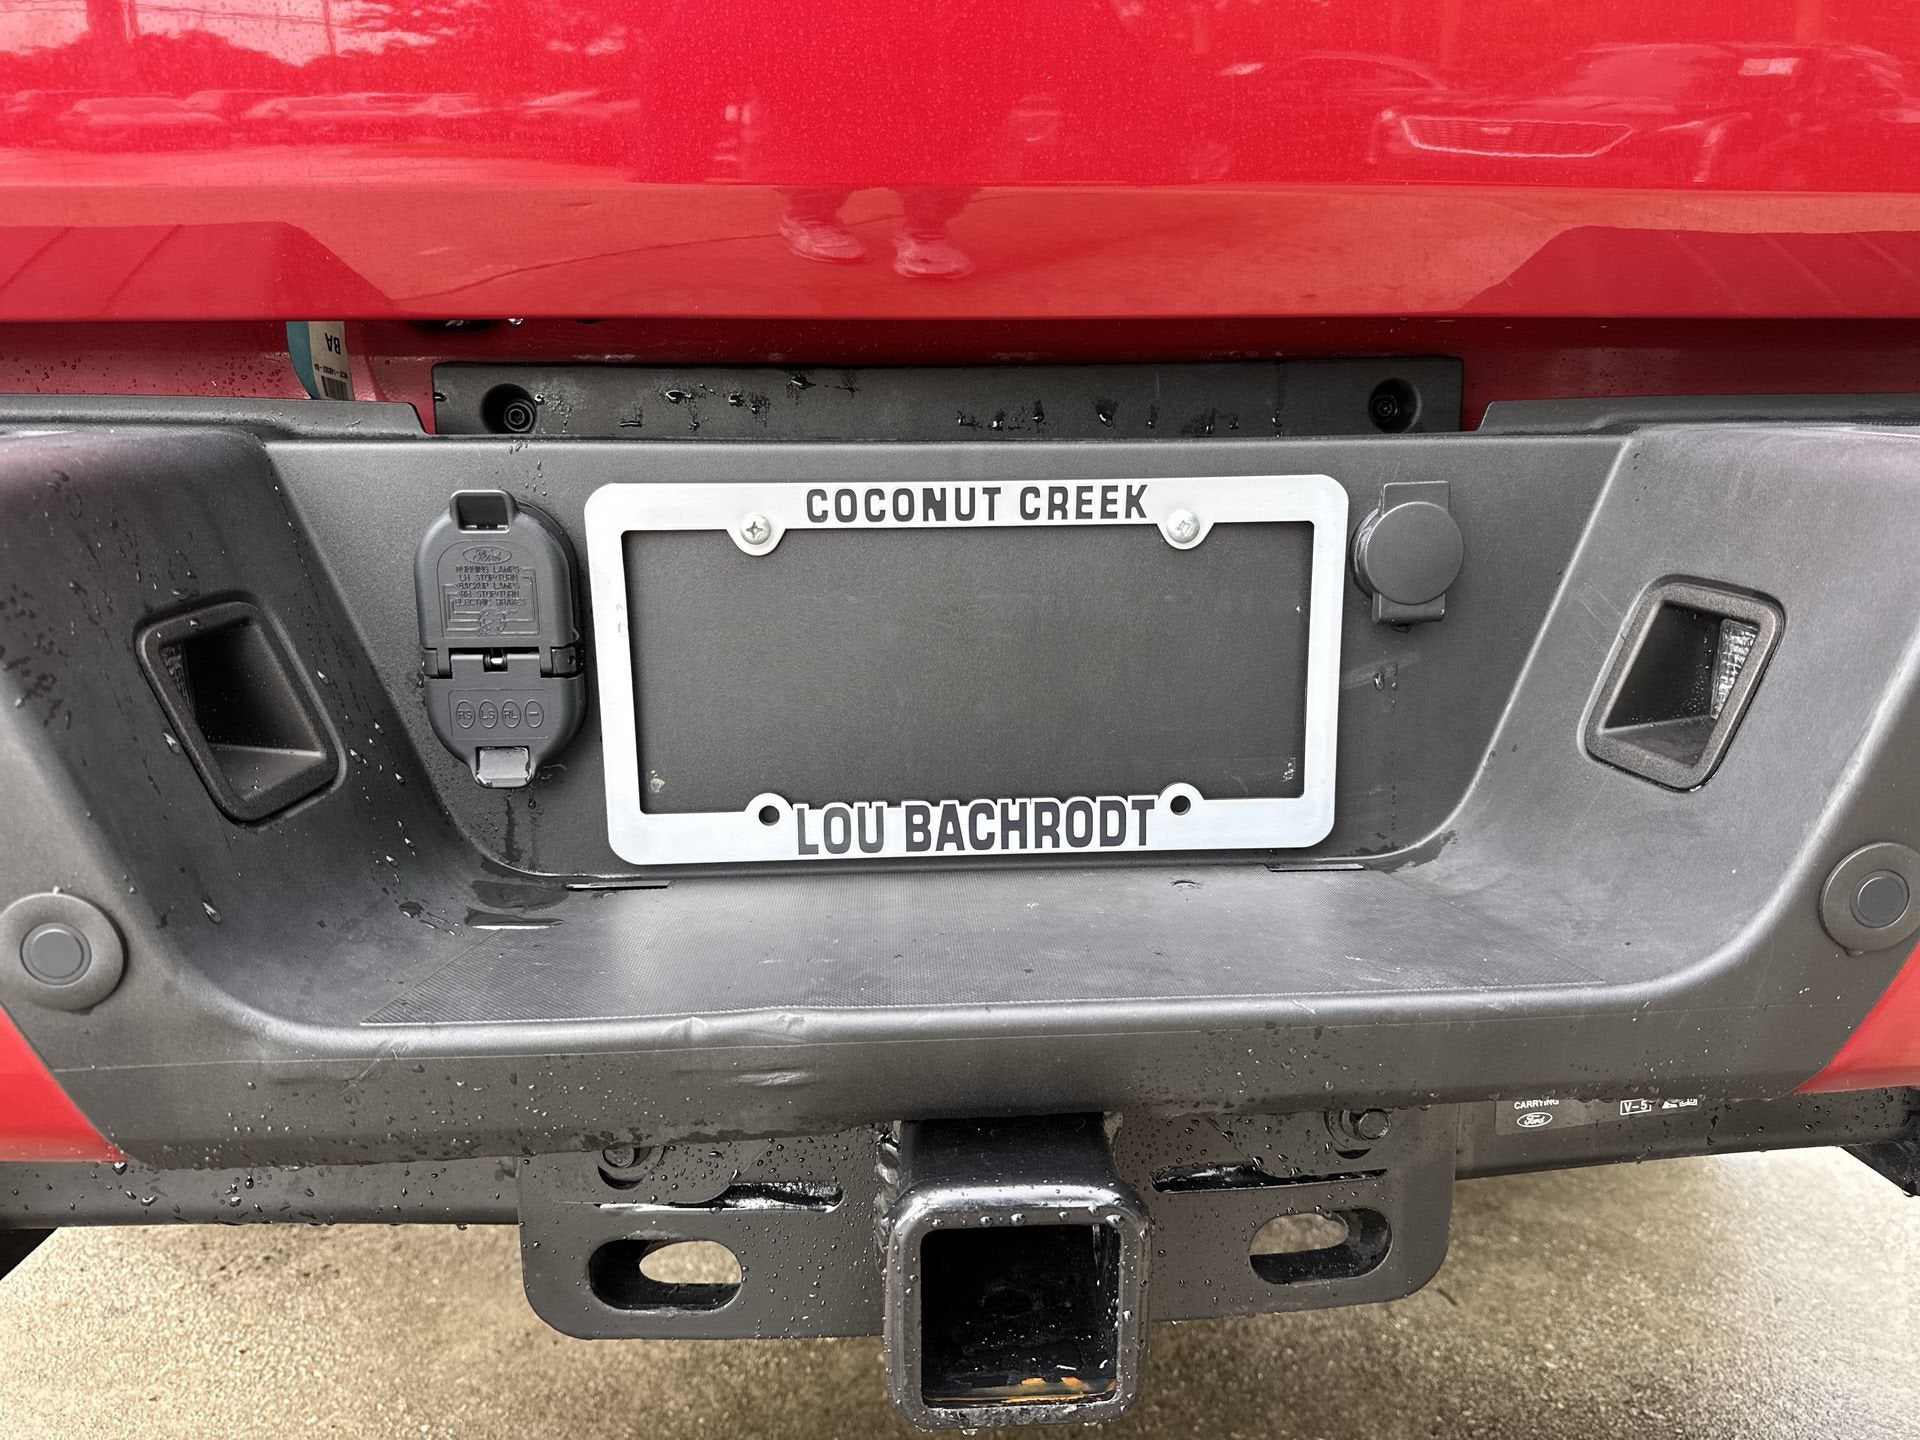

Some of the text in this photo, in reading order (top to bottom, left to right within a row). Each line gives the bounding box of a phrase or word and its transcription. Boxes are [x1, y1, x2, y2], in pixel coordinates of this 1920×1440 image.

[325, 333, 341, 355] BA
[806, 485, 1148, 523] COCONUT CREEK
[458, 709, 473, 720] RS
[481, 709, 496, 720] LS
[504, 709, 518, 720] RL
[797, 799, 1155, 855] LOU BACHRODT
